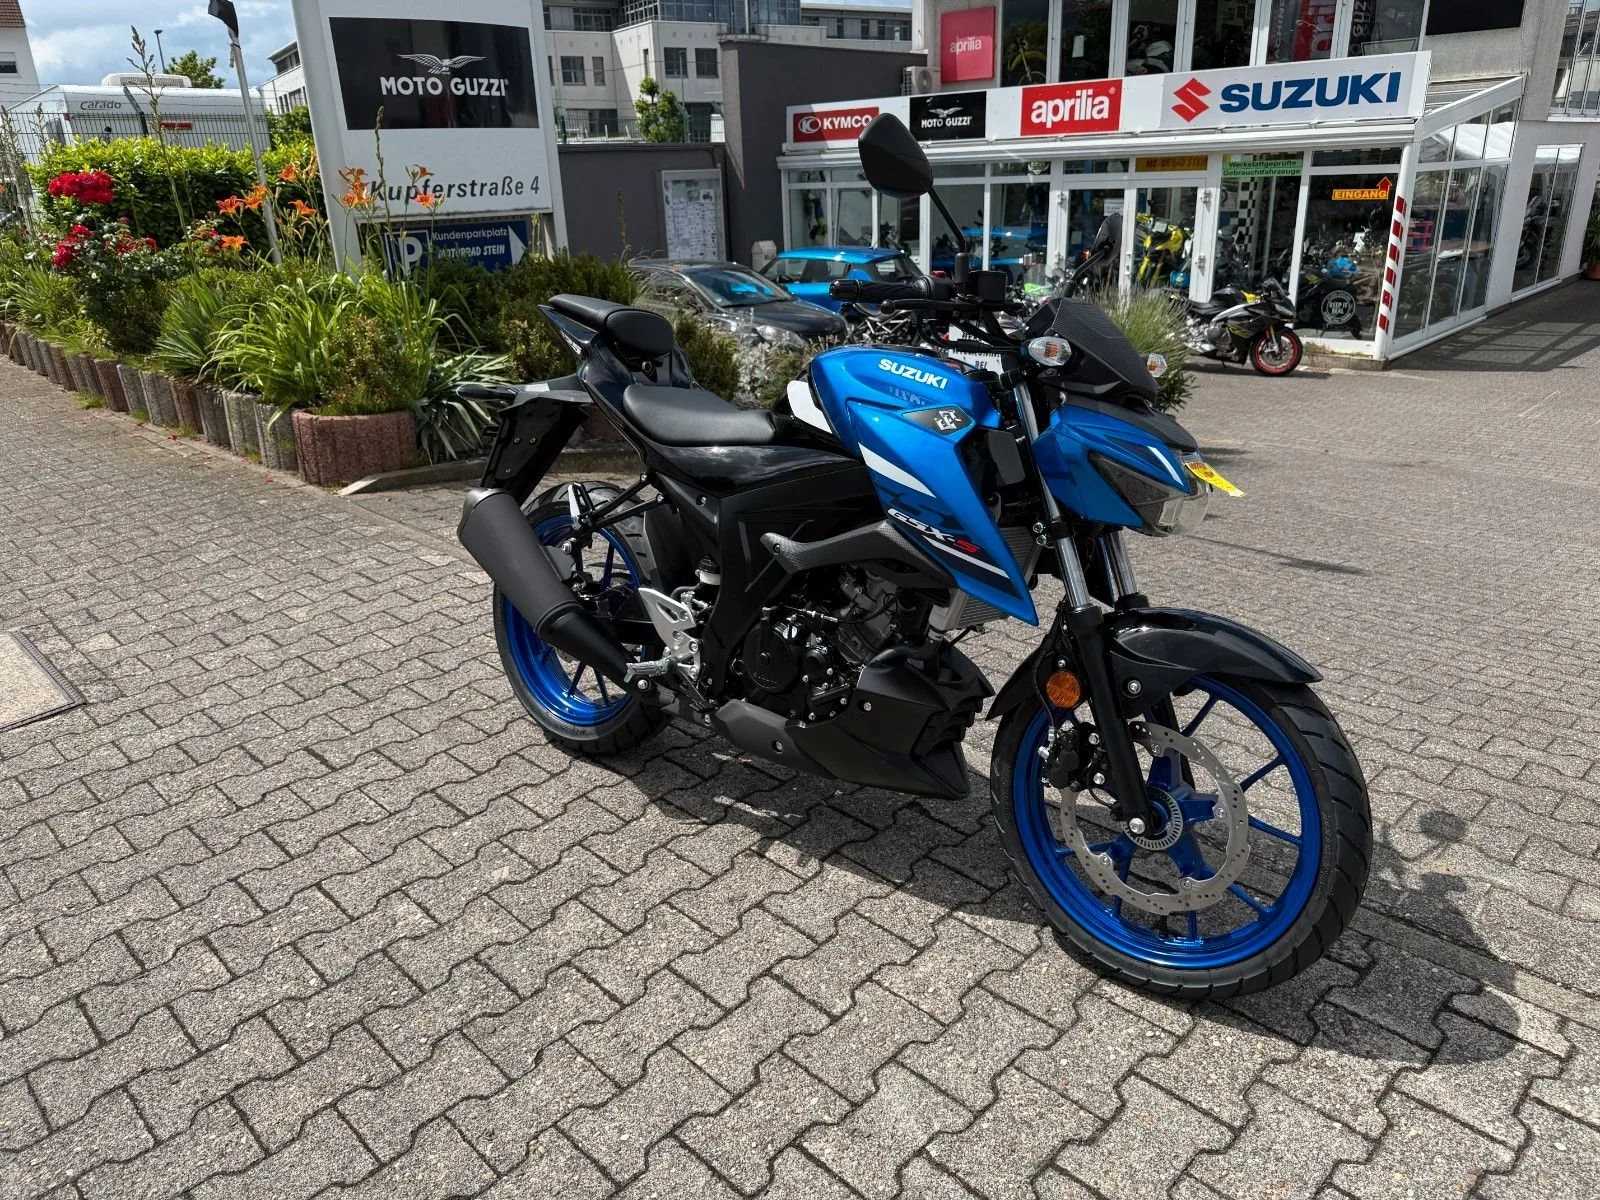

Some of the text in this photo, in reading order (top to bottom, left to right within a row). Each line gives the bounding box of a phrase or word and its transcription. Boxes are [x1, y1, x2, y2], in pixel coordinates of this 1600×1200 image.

[950, 37, 982, 54] aprilia
[380, 76, 506, 96] MOTO GUZZI
[1219, 71, 1401, 113] SUZUKI
[1030, 89, 1110, 128] aprilia
[823, 114, 873, 130] KYMCO
[921, 116, 970, 128] MOTO GUZZI
[530, 176, 540, 195] 4
[1334, 190, 1387, 199] EINGANG
[432, 228, 508, 240] Kundenparkplatz
[483, 245, 505, 255] STEIN
[878, 358, 948, 390] SUZUKI
[887, 508, 980, 554] GSX-S
